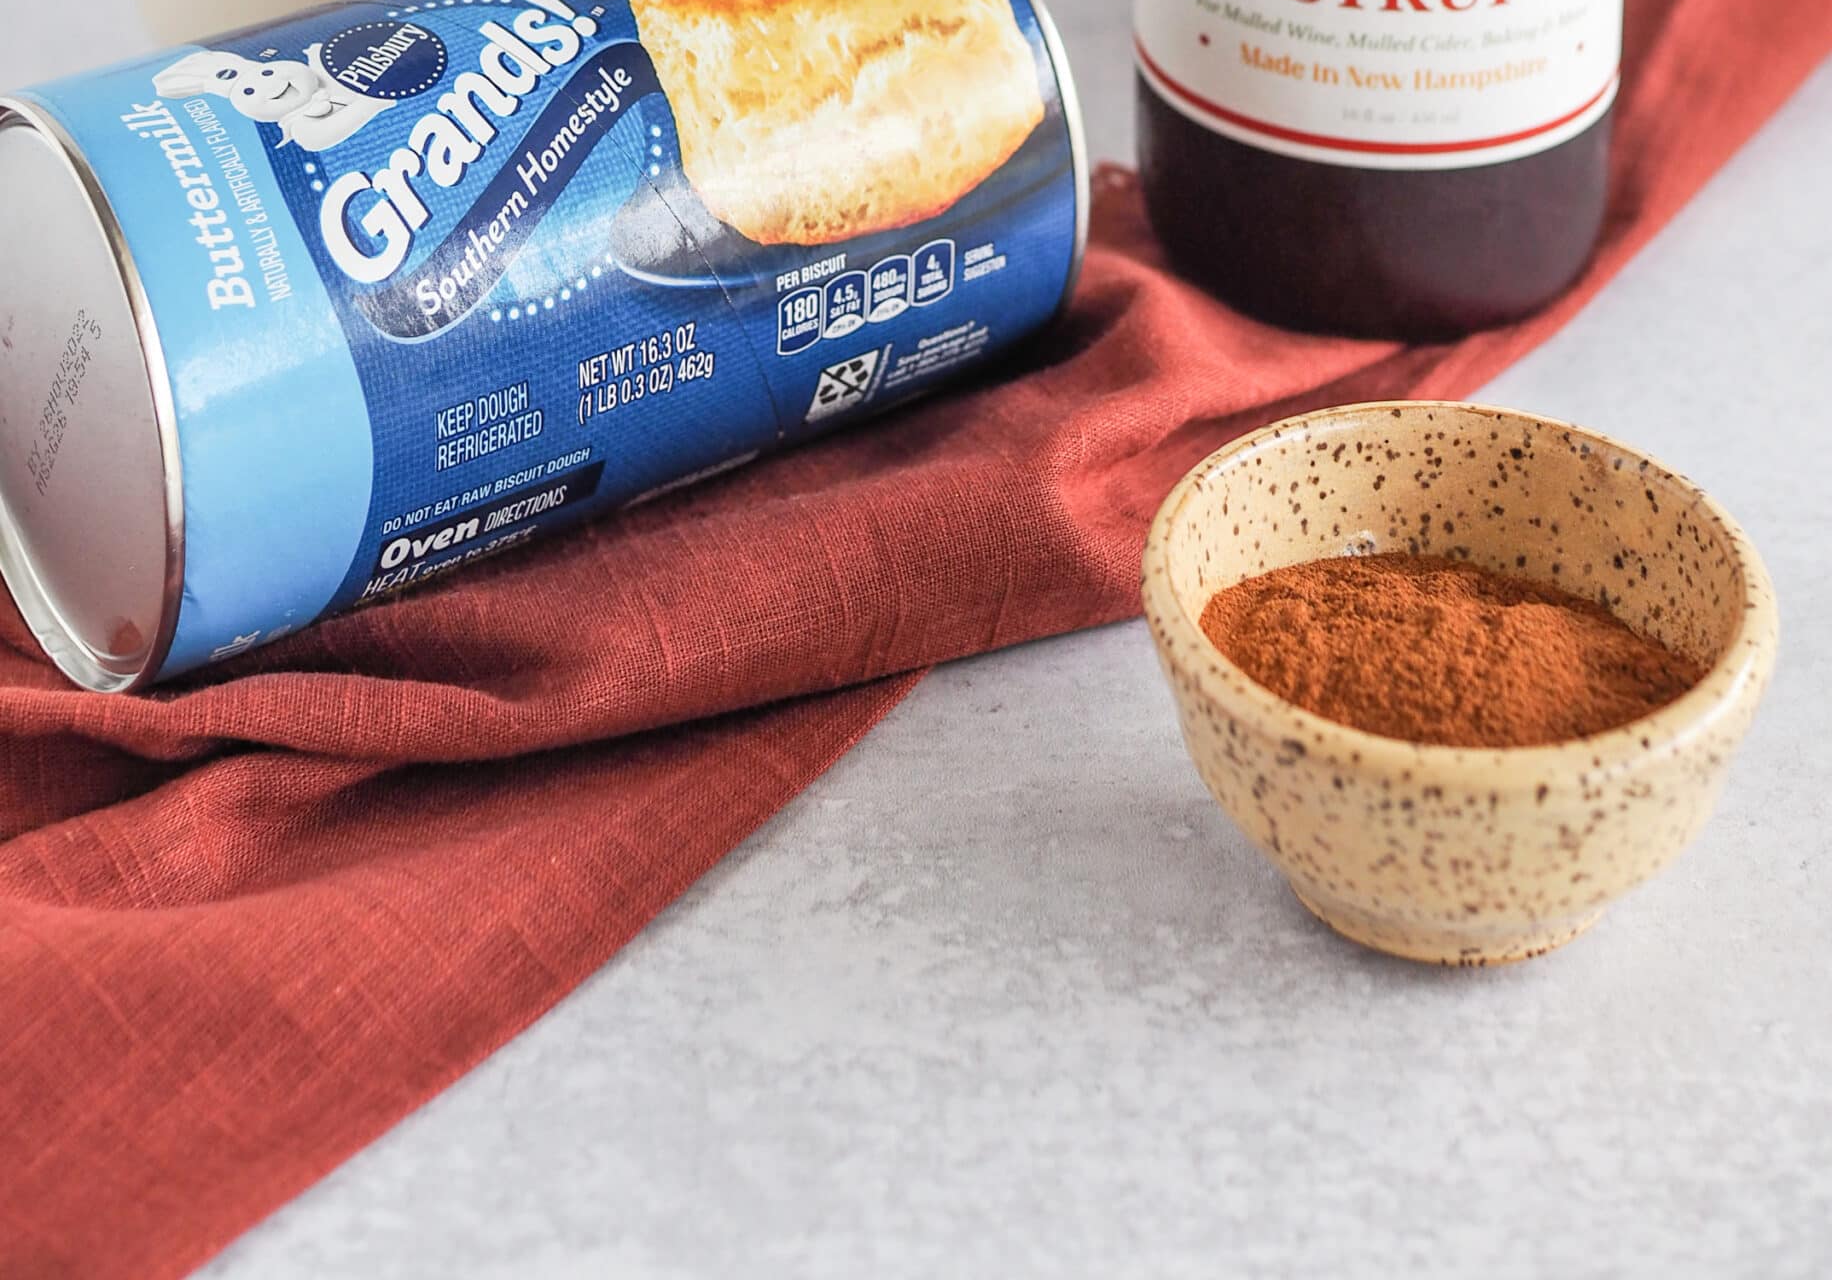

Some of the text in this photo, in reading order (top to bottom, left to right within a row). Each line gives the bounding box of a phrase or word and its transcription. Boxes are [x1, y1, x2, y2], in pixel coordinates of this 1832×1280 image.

[335, 20, 430, 93] Pillsbury
[1240, 41, 1304, 80] Made
[1347, 64, 1403, 90] New
[1413, 56, 1548, 92] Hampshire
[183, 98, 228, 145] FLAVORED
[120, 100, 256, 310] Buttermilk
[212, 144, 262, 214] ARTIFICIALLY
[415, 61, 633, 315] Southern Homestyle
[248, 226, 293, 302] NATURALLY
[776, 253, 847, 293] PER BISCUIT
[783, 292, 818, 327] 180
[578, 323, 696, 389] NET WT 16.3 OZ
[578, 352, 714, 425] (1 LB 0.3 OZ) 462g
[436, 382, 528, 440] KEEP DOUGH
[437, 410, 543, 471] REFRIGERATED
[382, 448, 591, 535] DO NOT EAT RAW BISCUIT DOUGH
[380, 517, 480, 569] Oven
[484, 485, 568, 533] DIRECTIONS
[361, 561, 426, 598] HEAT
